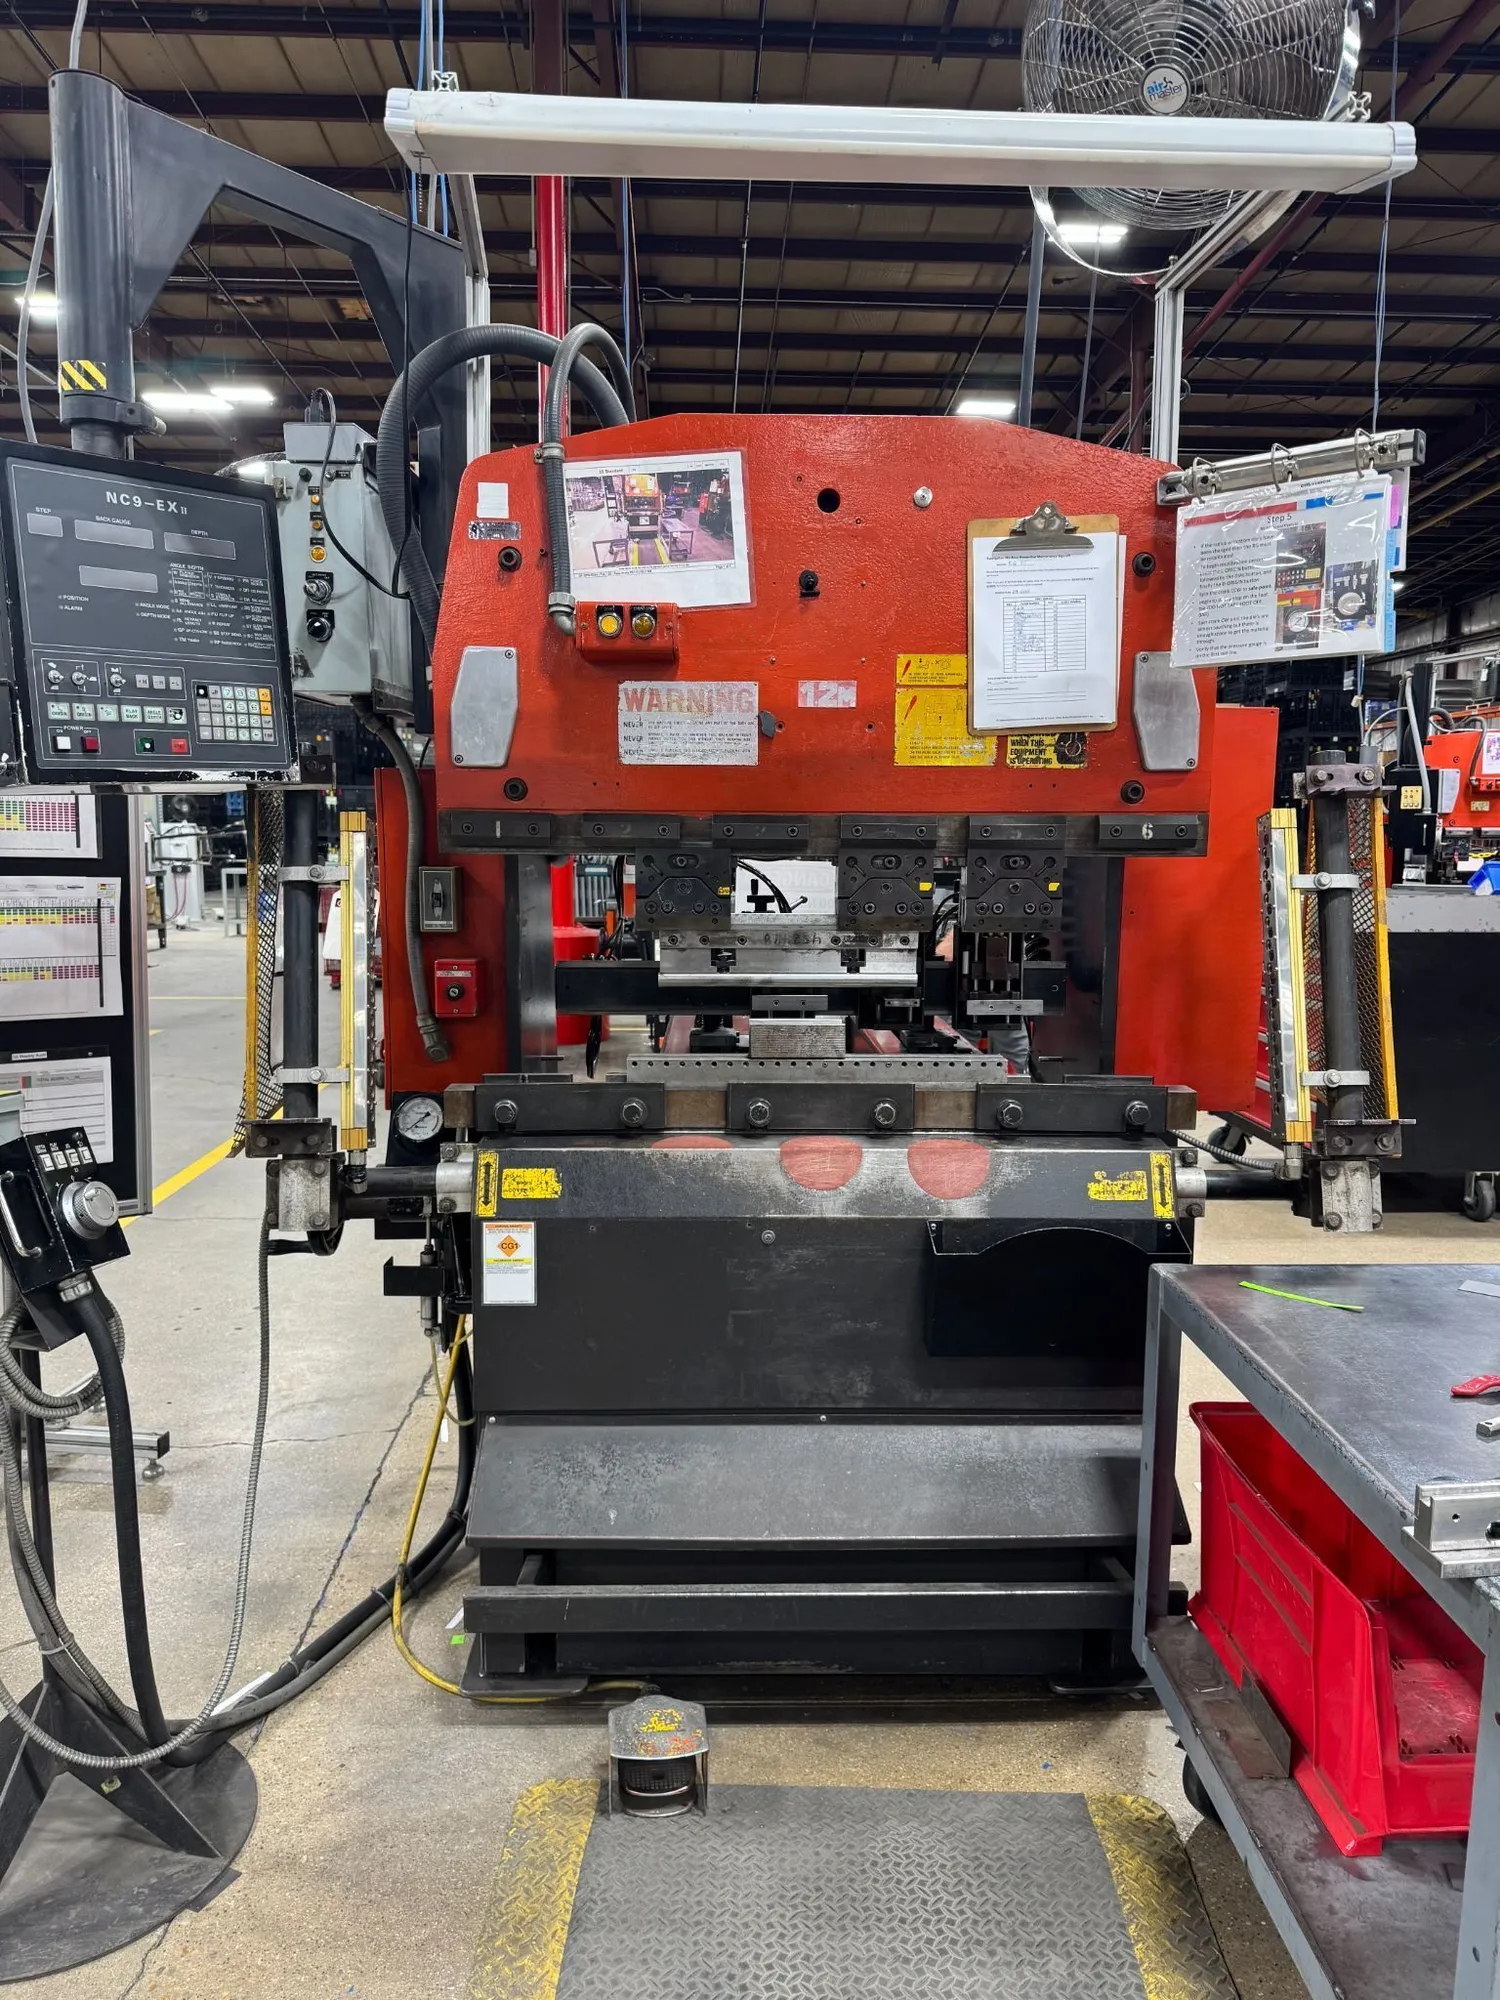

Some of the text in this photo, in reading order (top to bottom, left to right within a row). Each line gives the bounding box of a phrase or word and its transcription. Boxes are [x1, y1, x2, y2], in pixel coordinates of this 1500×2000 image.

[1147, 81, 1164, 94] air
[1149, 85, 1183, 102] master
[35, 506, 52, 514] STEP
[1267, 513, 1292, 524] Step 5
[799, 681, 856, 707] 12M
[624, 687, 754, 713] WARNING
[623, 735, 643, 743] NEVER
[1031, 739, 1045, 747] THIS
[1010, 748, 1047, 756] EQUIPMENT
[1017, 757, 1053, 765] OPERATING
[1142, 822, 1155, 840] 6
[501, 1242, 519, 1250] CG1
